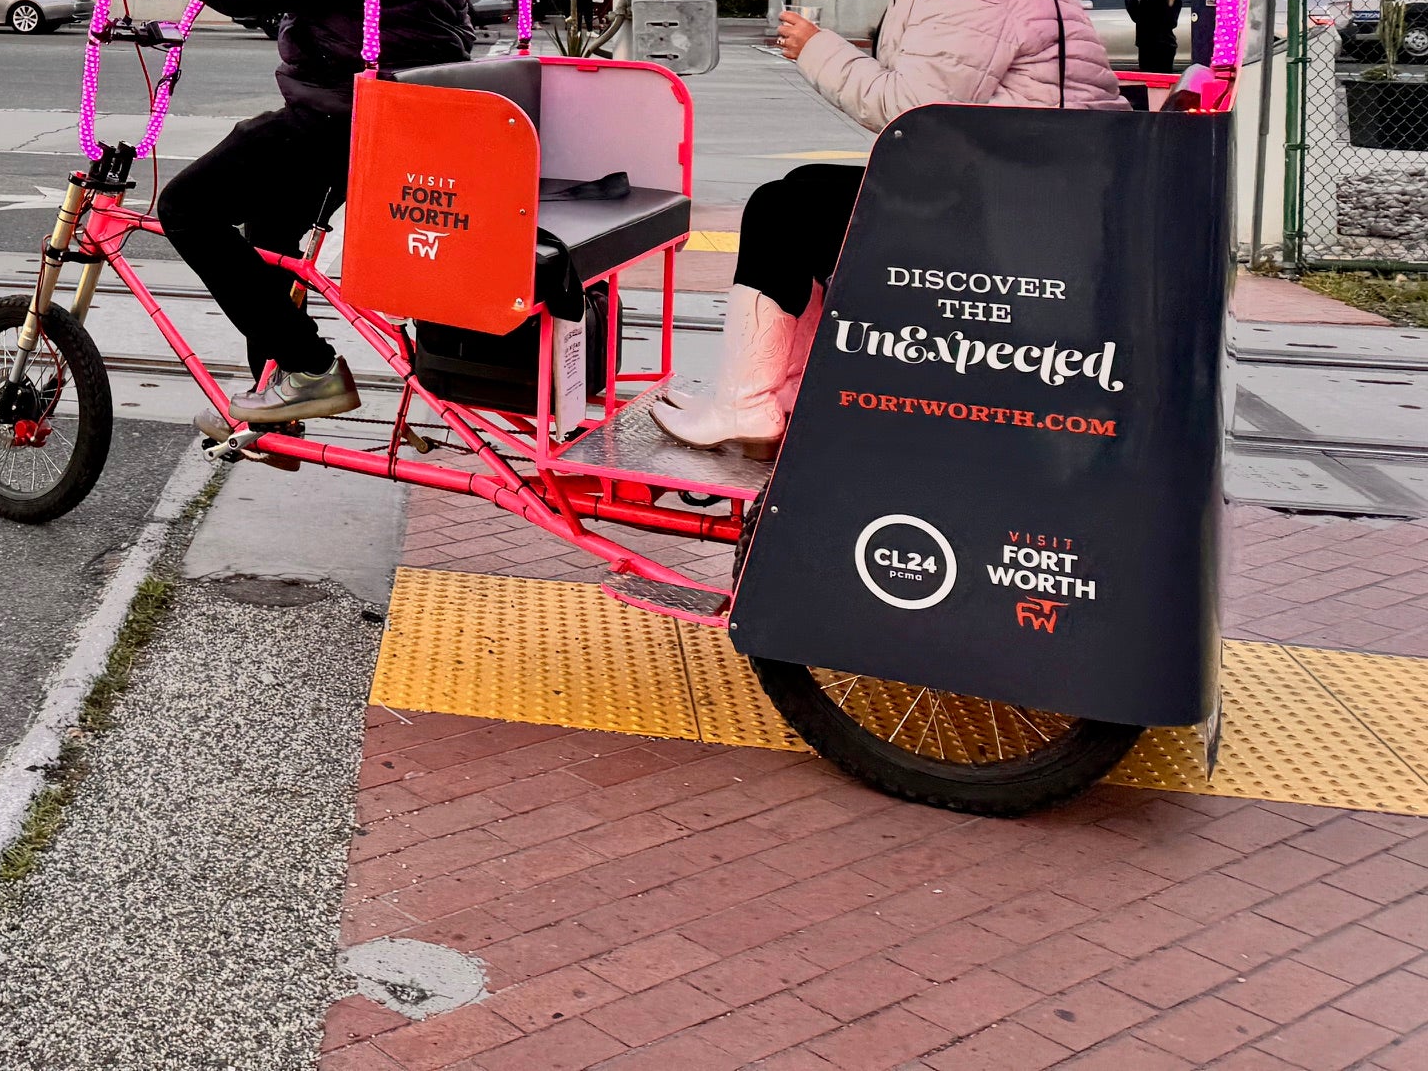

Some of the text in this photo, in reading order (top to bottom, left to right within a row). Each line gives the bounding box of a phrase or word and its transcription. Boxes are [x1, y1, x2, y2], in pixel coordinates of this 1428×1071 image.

[407, 172, 456, 189] VISIT
[401, 185, 457, 209] FORT
[388, 202, 470, 230] WORTH
[887, 266, 1067, 300] DISCOVER
[938, 298, 1012, 324] THE
[838, 389, 1117, 437] FORTWORTH.COM
[1008, 530, 1075, 550] VISIT
[873, 546, 938, 575] CL24
[1003, 544, 1079, 574] FORT
[889, 568, 923, 582] pcma
[986, 563, 1097, 601] WORTH
